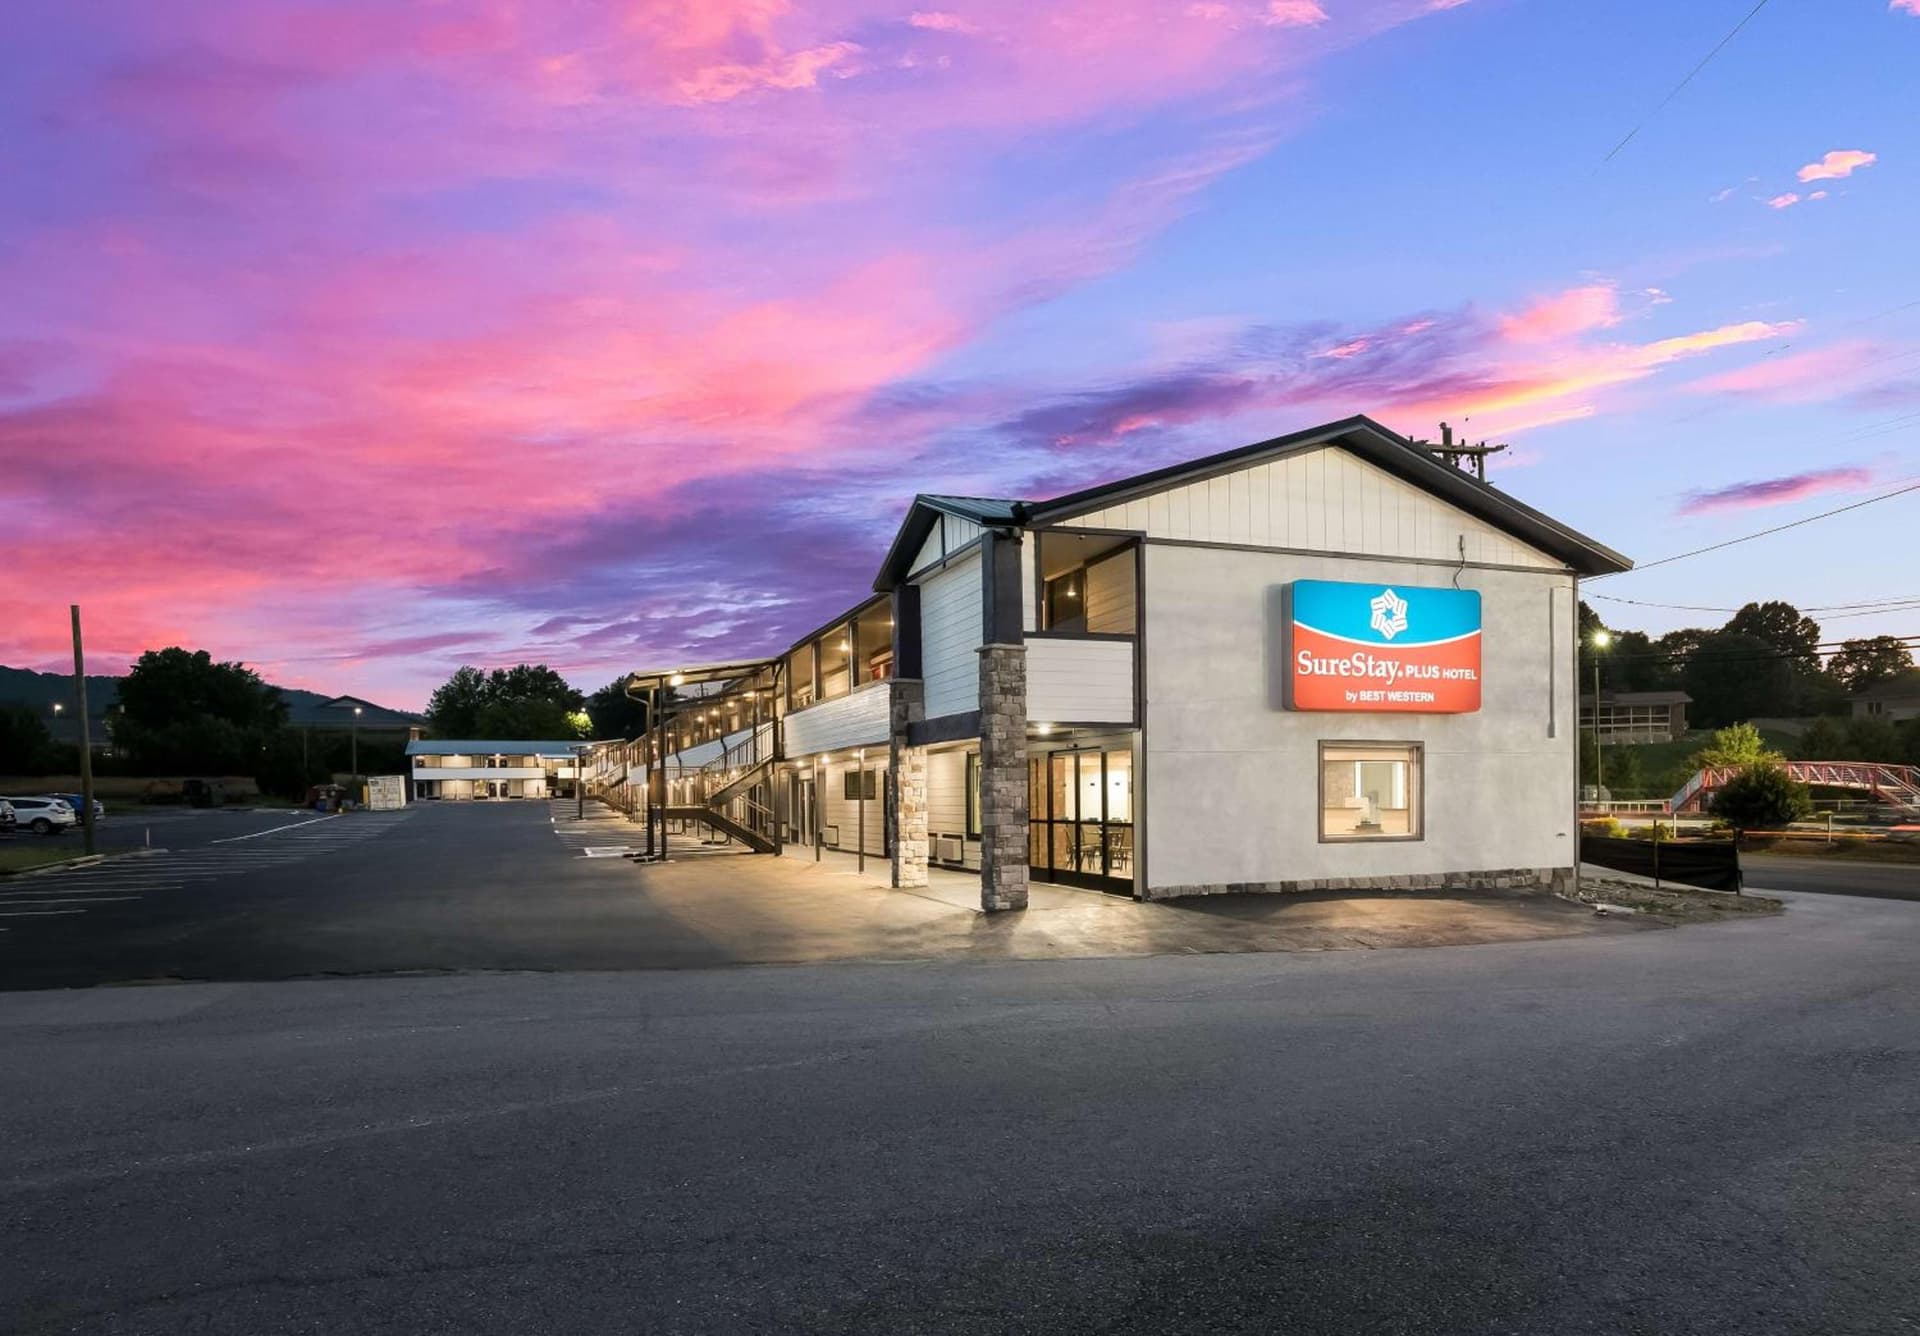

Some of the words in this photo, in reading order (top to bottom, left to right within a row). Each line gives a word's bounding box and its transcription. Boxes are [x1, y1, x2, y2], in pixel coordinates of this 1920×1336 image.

[1405, 665, 1440, 679] PLUS
[1442, 668, 1478, 680] HOTEL
[1345, 690, 1358, 703] by
[1359, 690, 1386, 702] BEST
[1387, 691, 1435, 702] WESTERN
